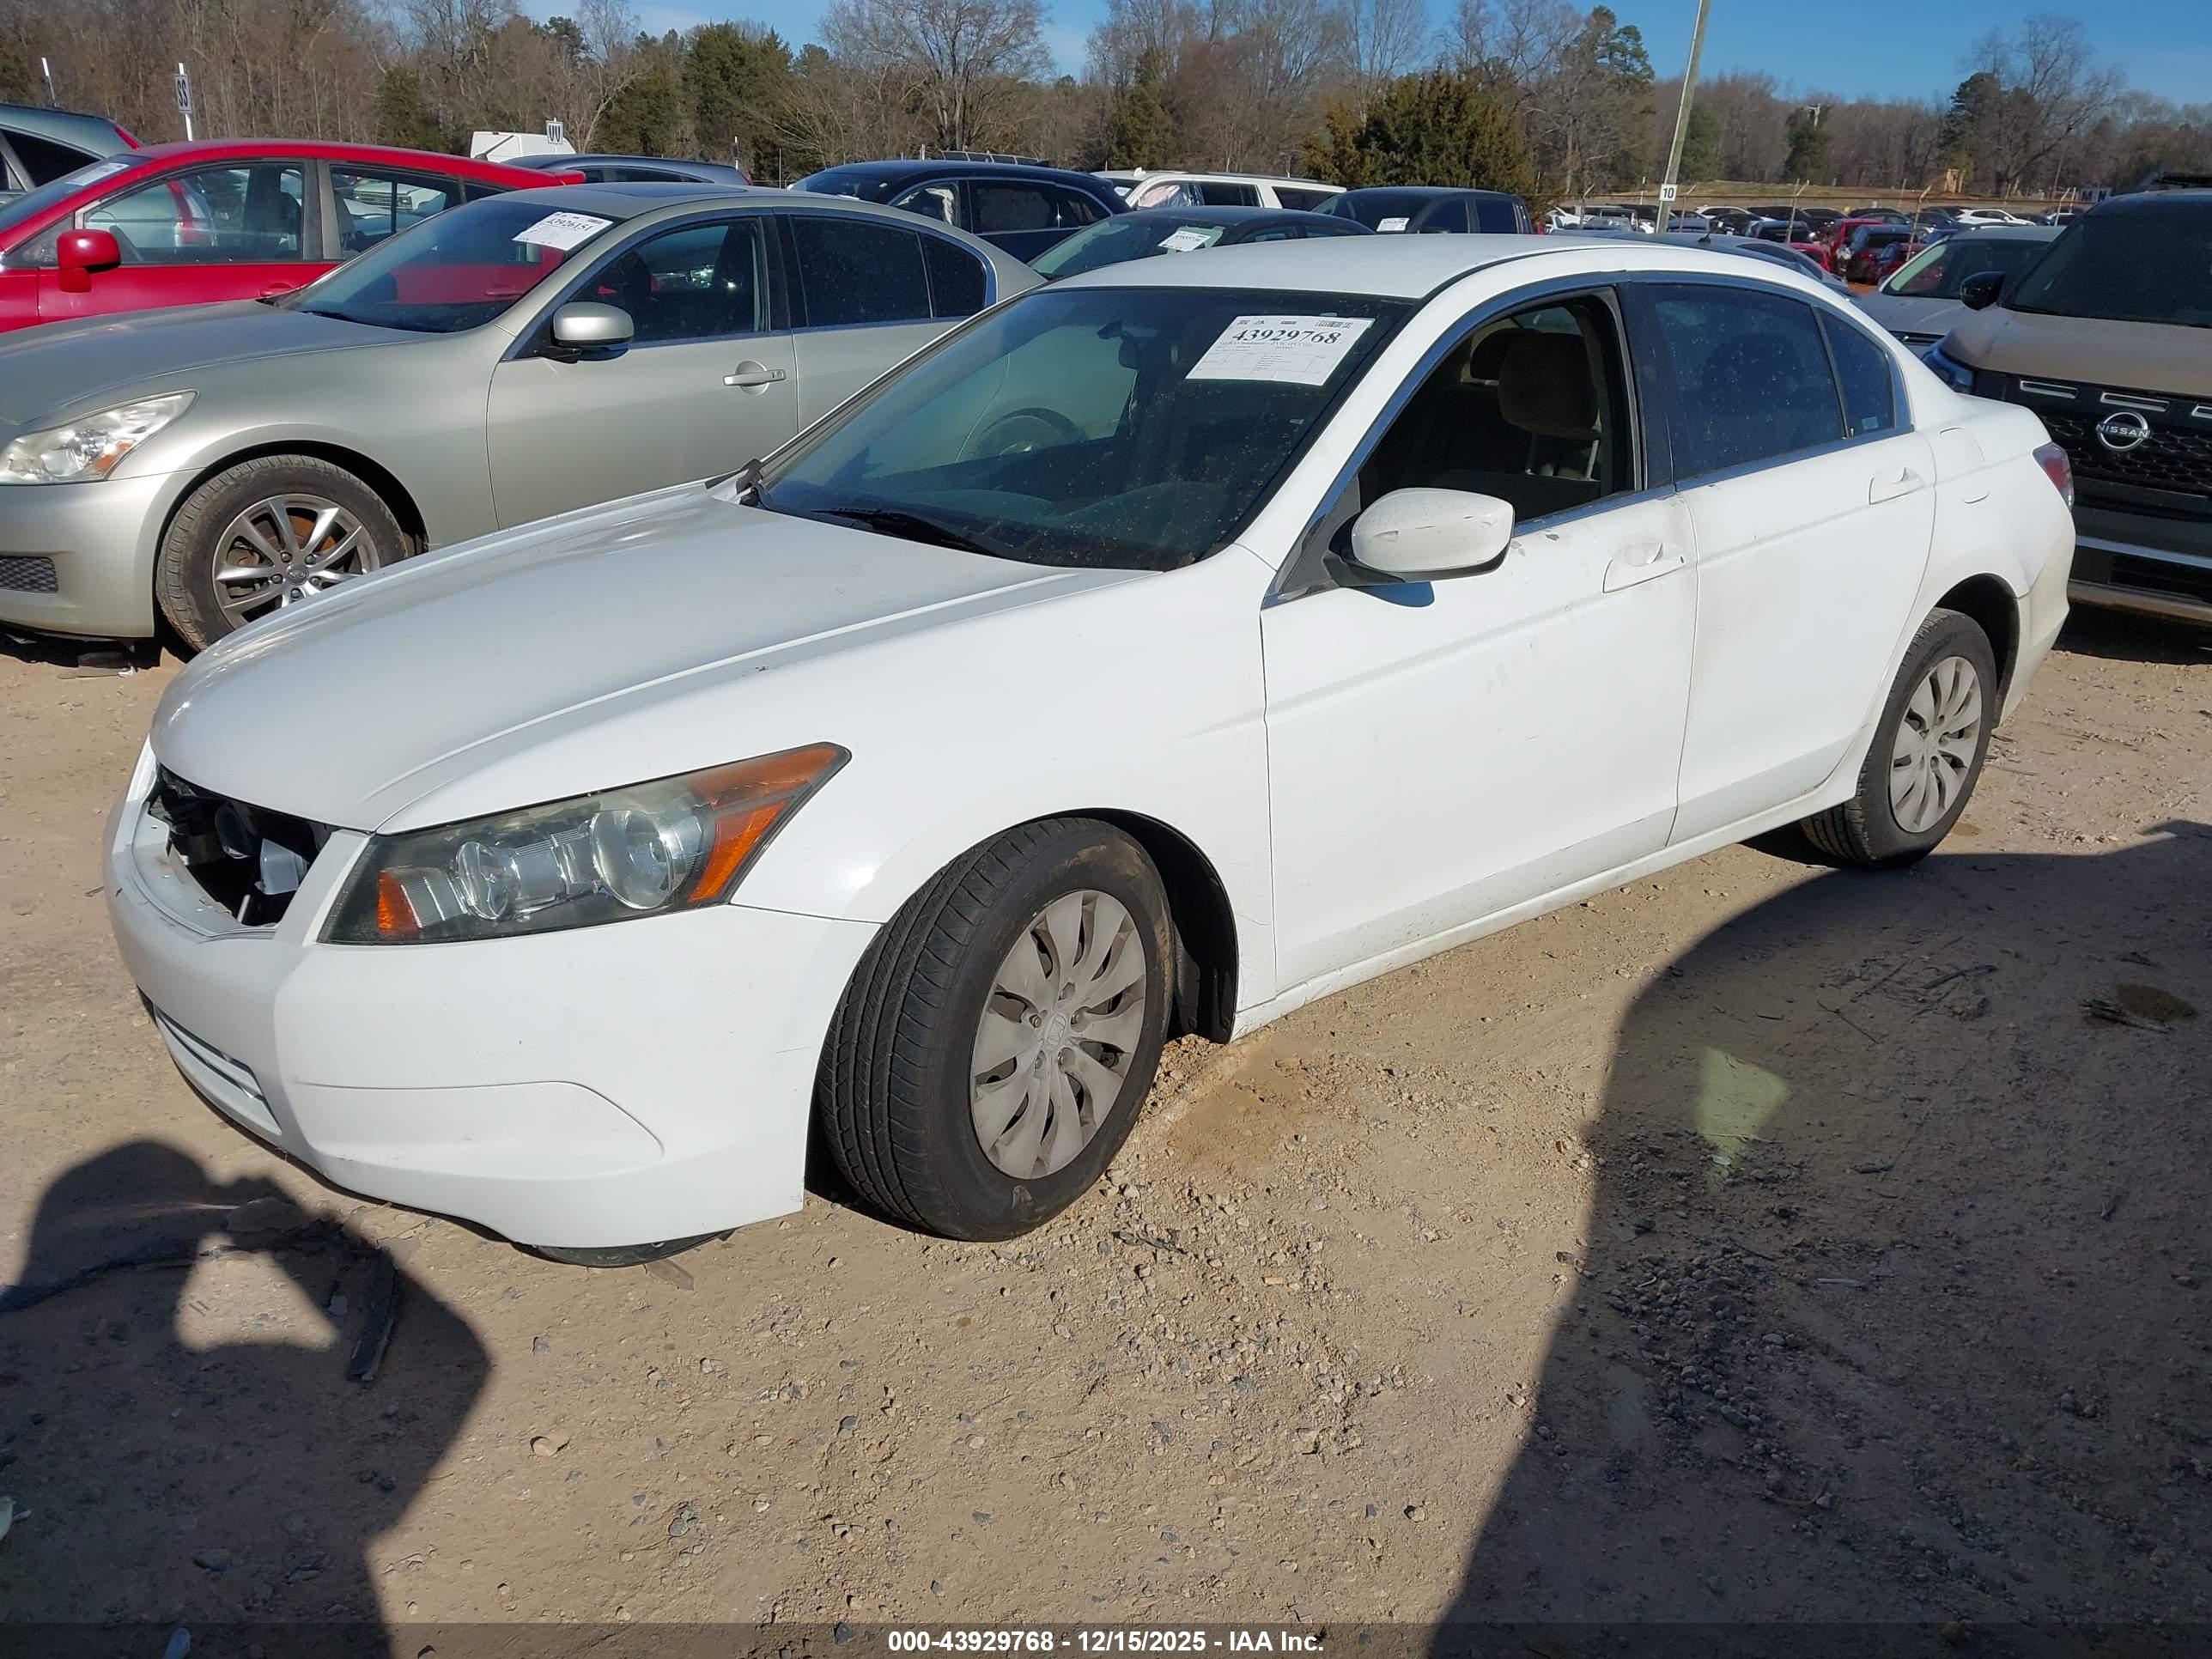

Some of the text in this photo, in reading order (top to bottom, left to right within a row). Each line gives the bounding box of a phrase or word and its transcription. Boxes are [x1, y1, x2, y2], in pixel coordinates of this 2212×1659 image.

[1662, 186, 1675, 199] 10
[1231, 329, 1342, 344] 43929768
[2095, 423, 2151, 439] NISSAN
